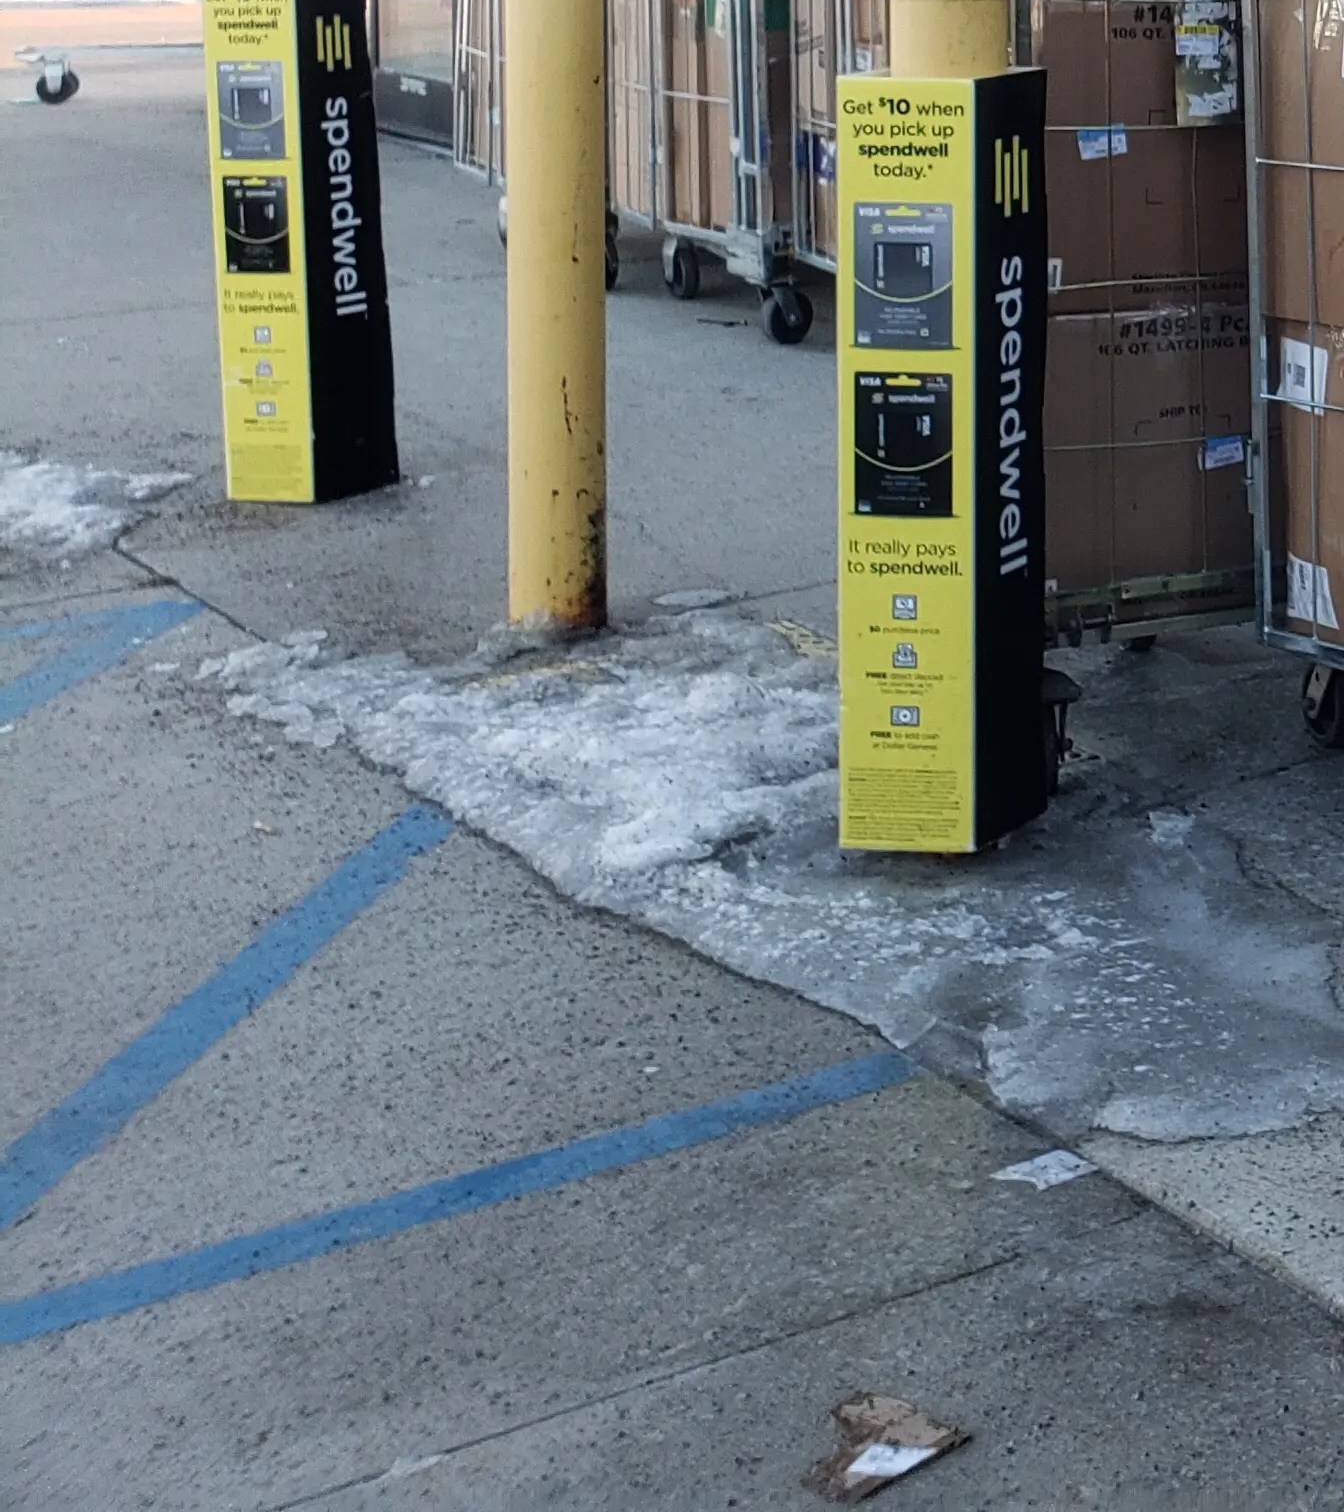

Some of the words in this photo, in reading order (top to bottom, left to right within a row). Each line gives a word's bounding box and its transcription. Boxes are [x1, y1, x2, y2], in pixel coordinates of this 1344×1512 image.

[213, 8, 234, 17] you
[238, 5, 262, 17] pick
[266, 8, 281, 18] up
[217, 19, 278, 32] spendwell
[1111, 27, 1137, 39] 106
[842, 99, 873, 115] Get
[878, 96, 911, 116] $10
[916, 101, 965, 117] when
[853, 123, 885, 138] you
[890, 120, 927, 139] pick
[931, 125, 955, 140] up
[858, 141, 949, 159] spendwell
[321, 95, 369, 318] spendwell
[1156, 337, 1235, 353] LATCHING
[995, 254, 1028, 576] spendwell
[1158, 406, 1185, 418] SHIP
[849, 538, 860, 554] It
[865, 538, 912, 558] really
[915, 542, 957, 559] pays
[847, 559, 865, 574] to
[869, 559, 964, 577] spendwell.
